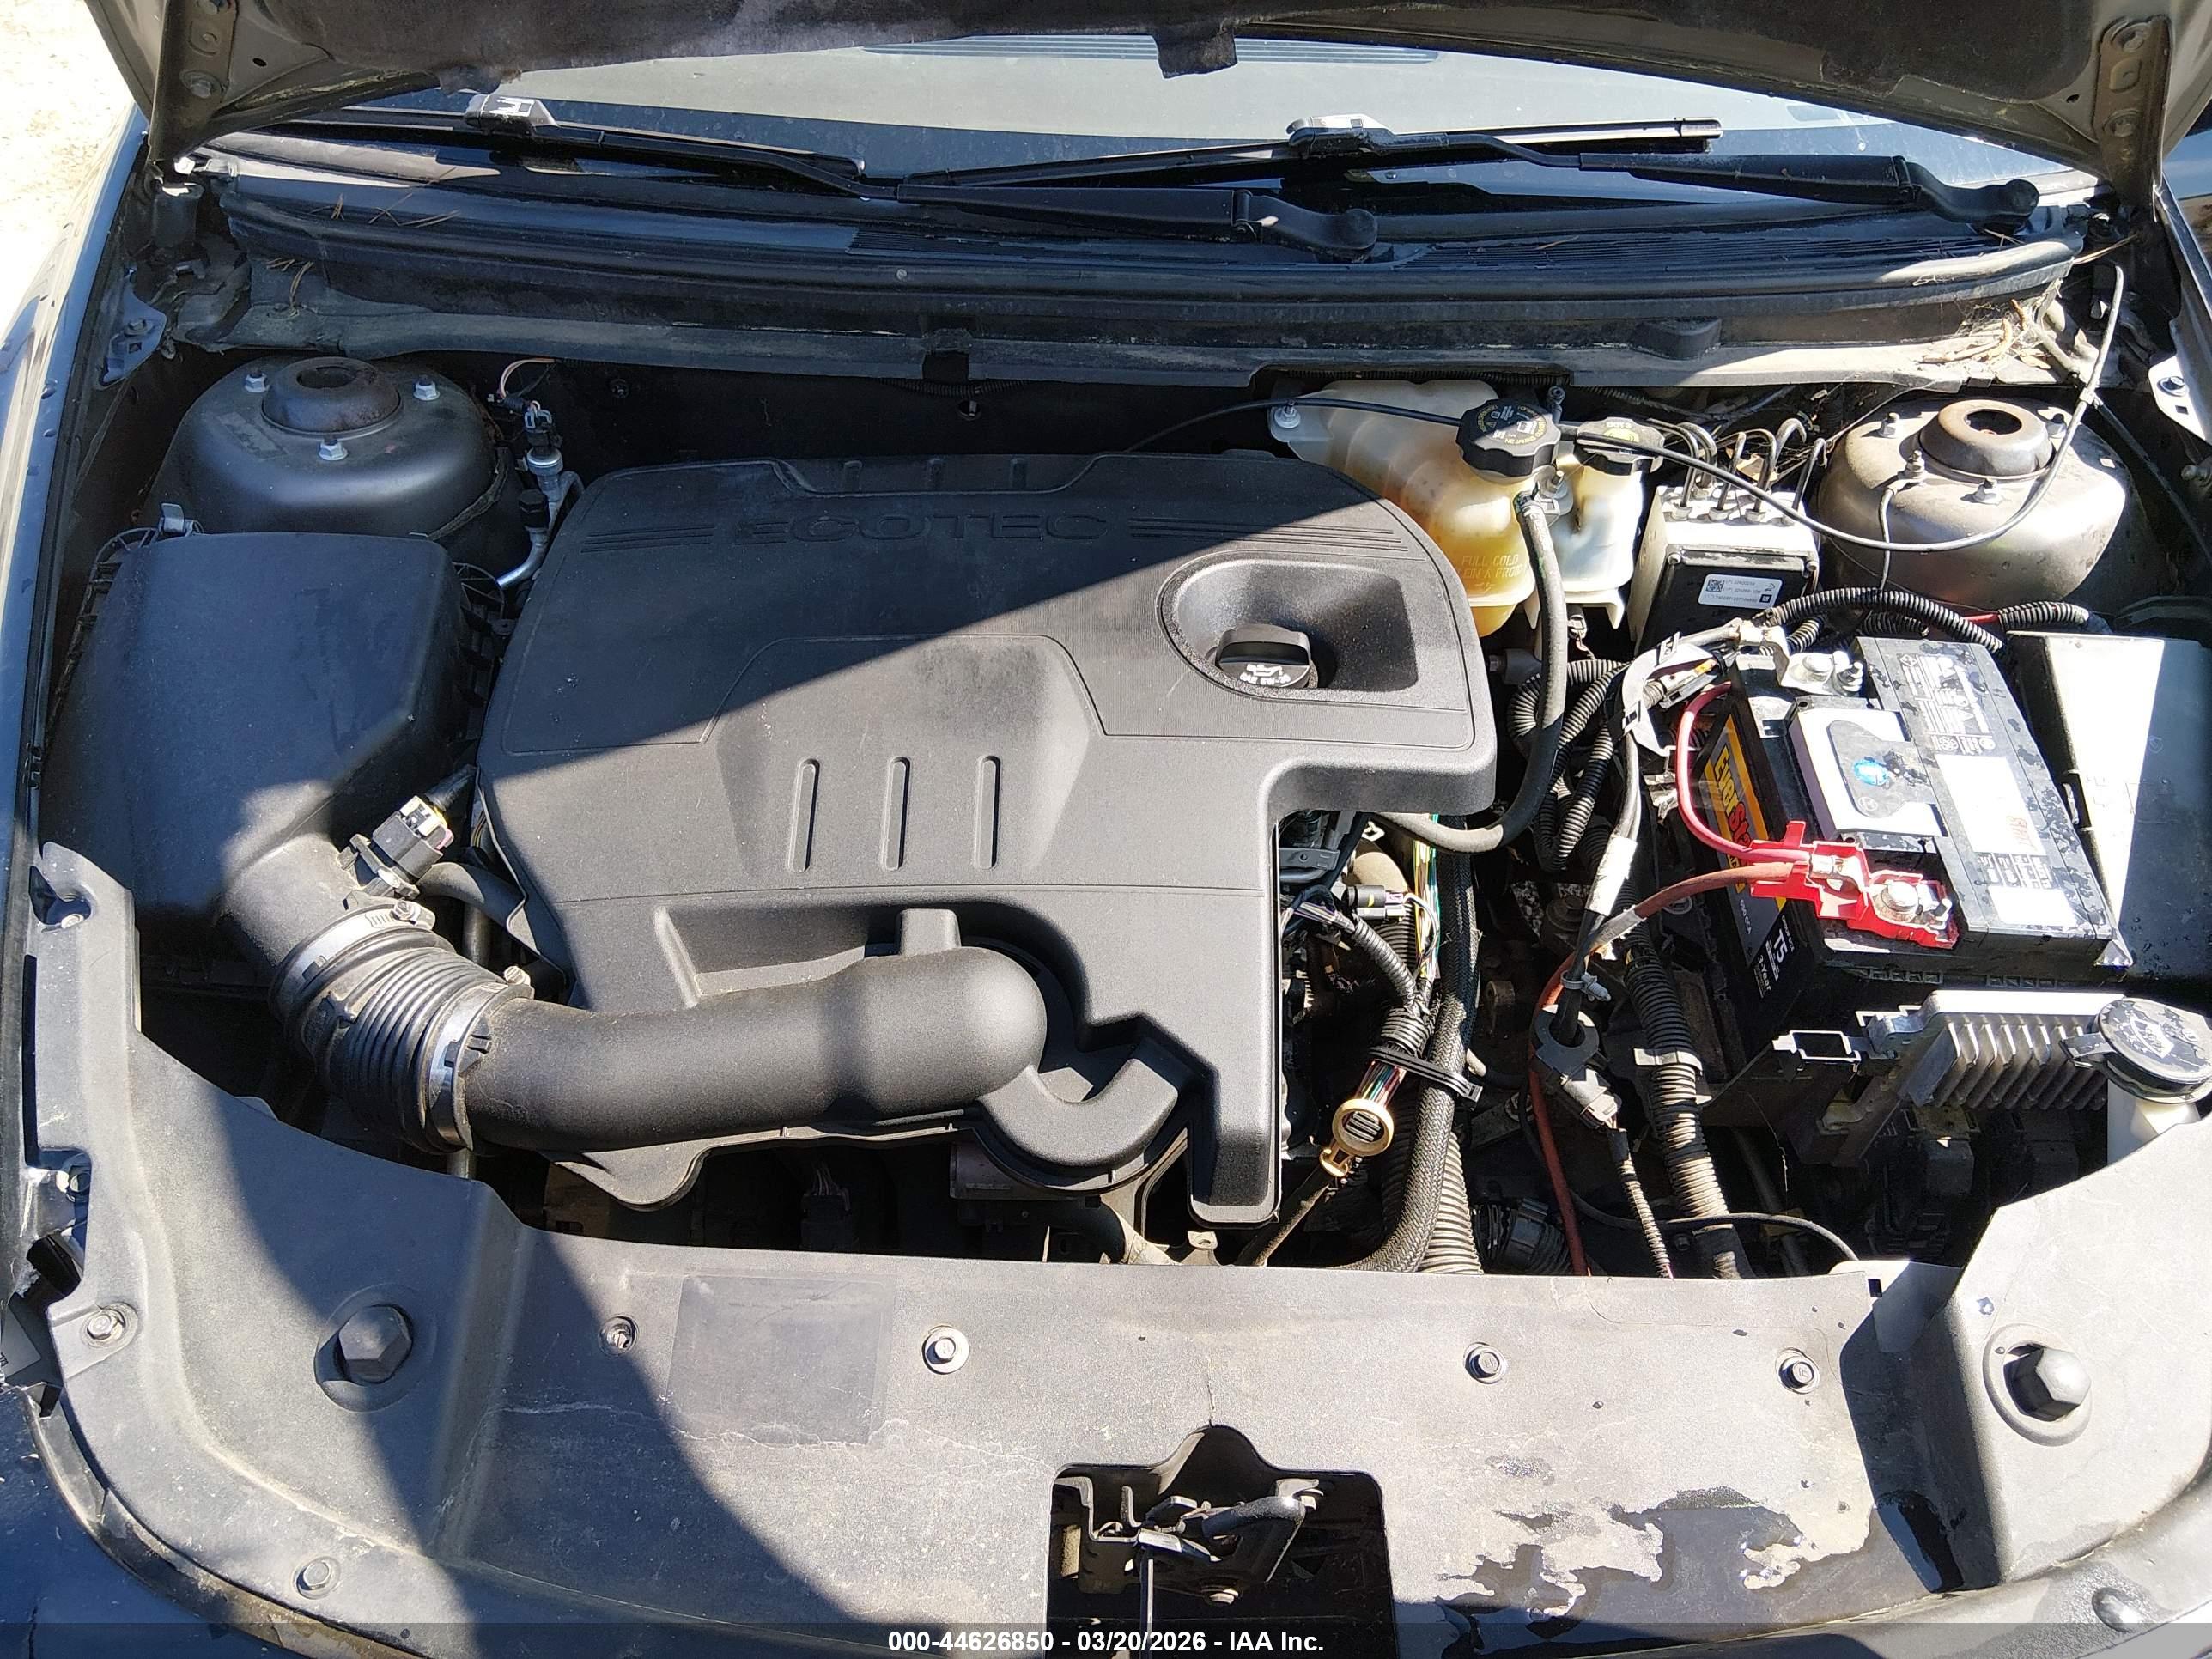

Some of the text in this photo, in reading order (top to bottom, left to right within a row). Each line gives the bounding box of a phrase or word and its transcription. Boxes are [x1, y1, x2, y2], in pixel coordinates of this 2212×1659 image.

[733, 514, 1109, 545] ECOTEC
[1462, 554, 1519, 567] FULL COLD
[1773, 928, 1789, 963] T5
[1758, 955, 1771, 991] 3-Year
